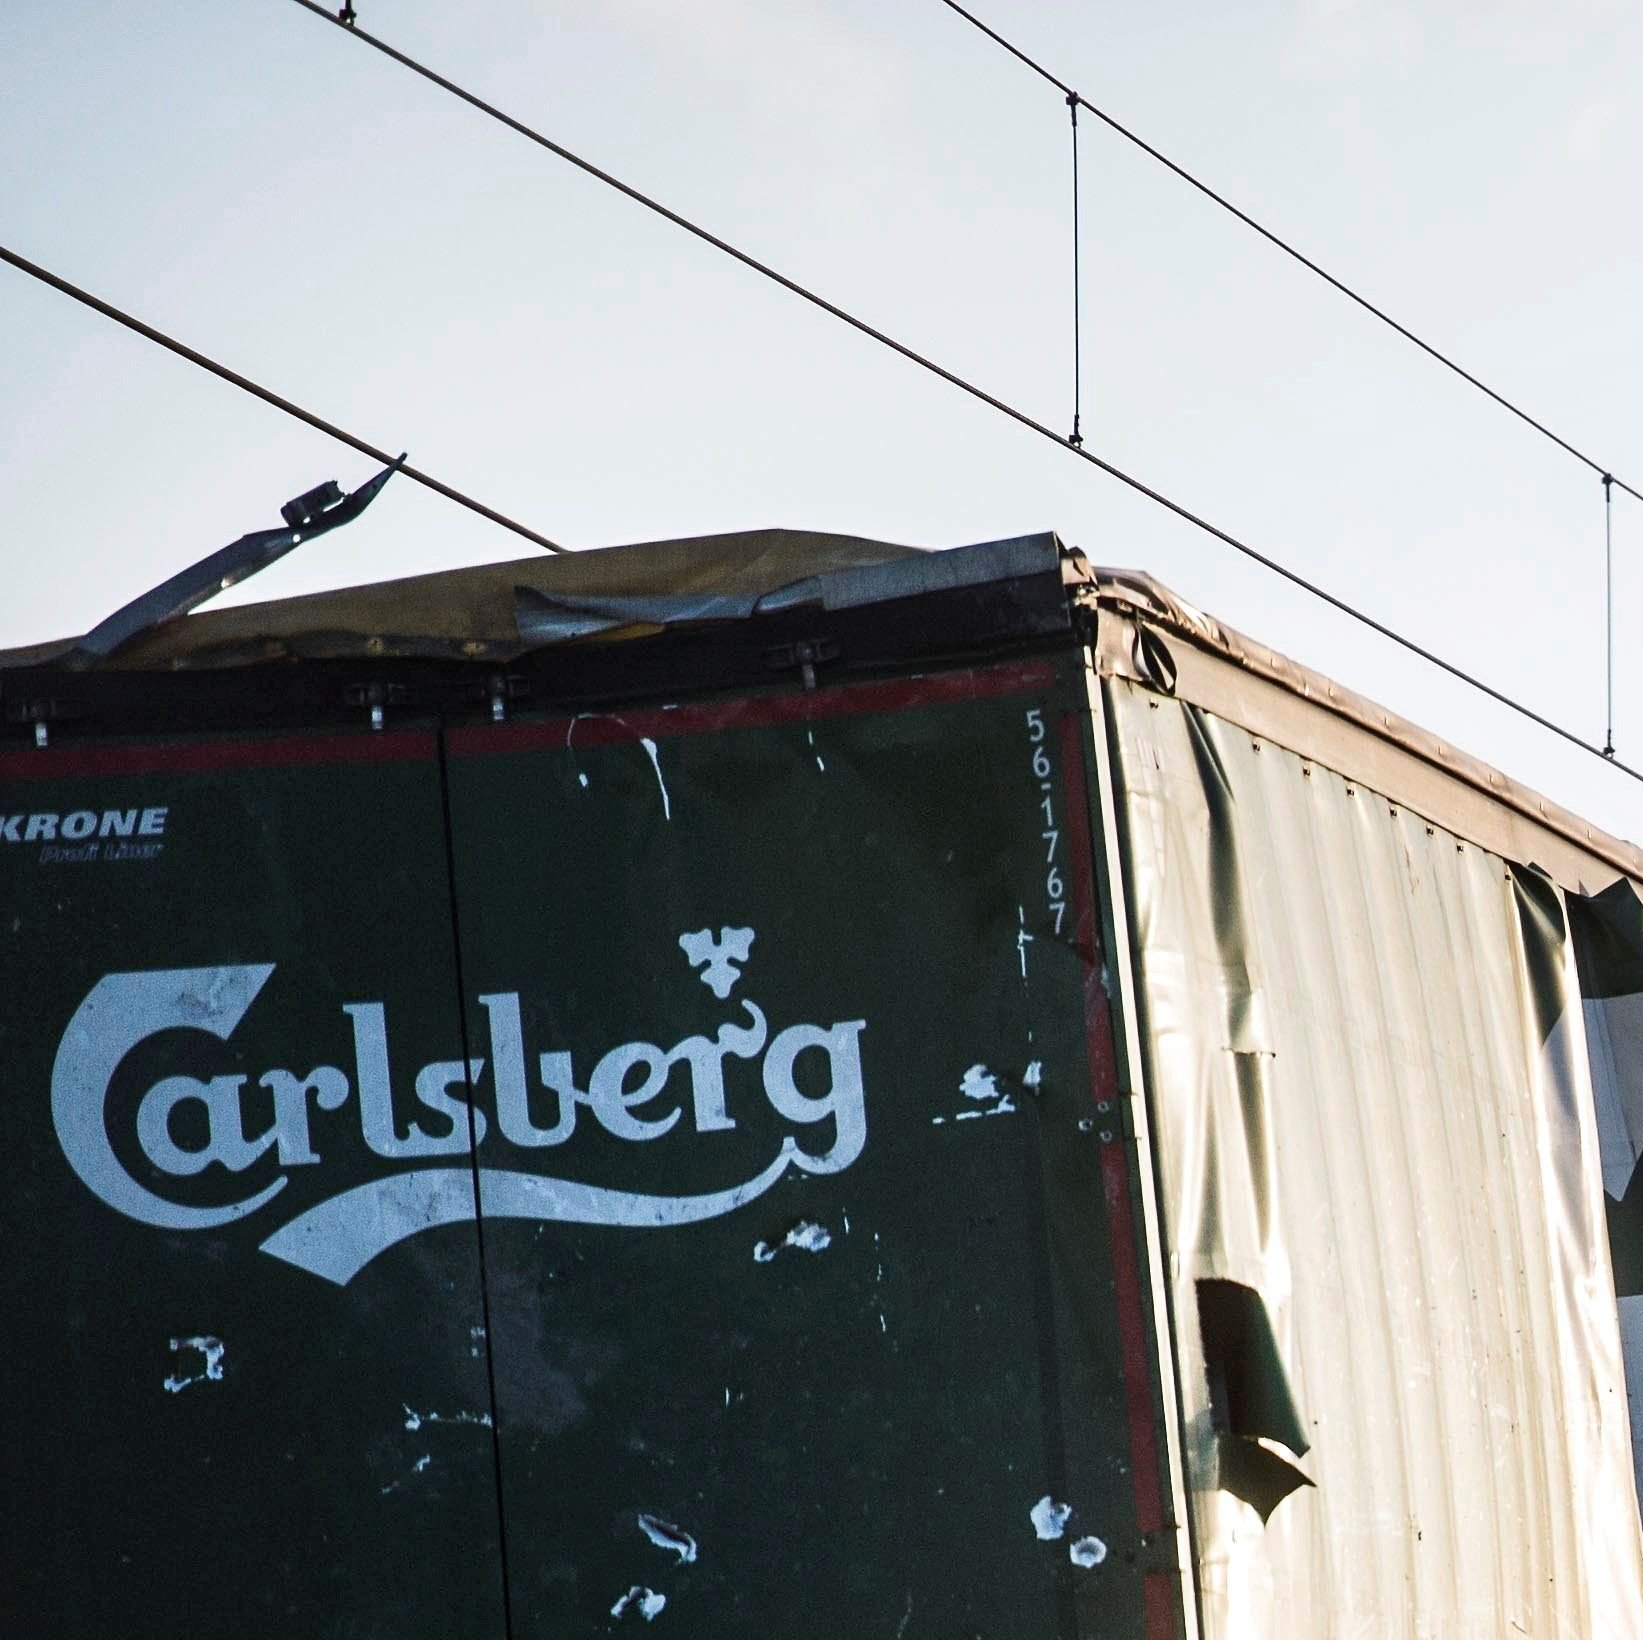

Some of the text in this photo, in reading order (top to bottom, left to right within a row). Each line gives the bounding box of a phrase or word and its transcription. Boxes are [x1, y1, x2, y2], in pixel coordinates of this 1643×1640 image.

[0, 807, 168, 842] KRONE
[1026, 708, 1066, 935] 56-1767
[51, 963, 866, 1231] Carlsberg
